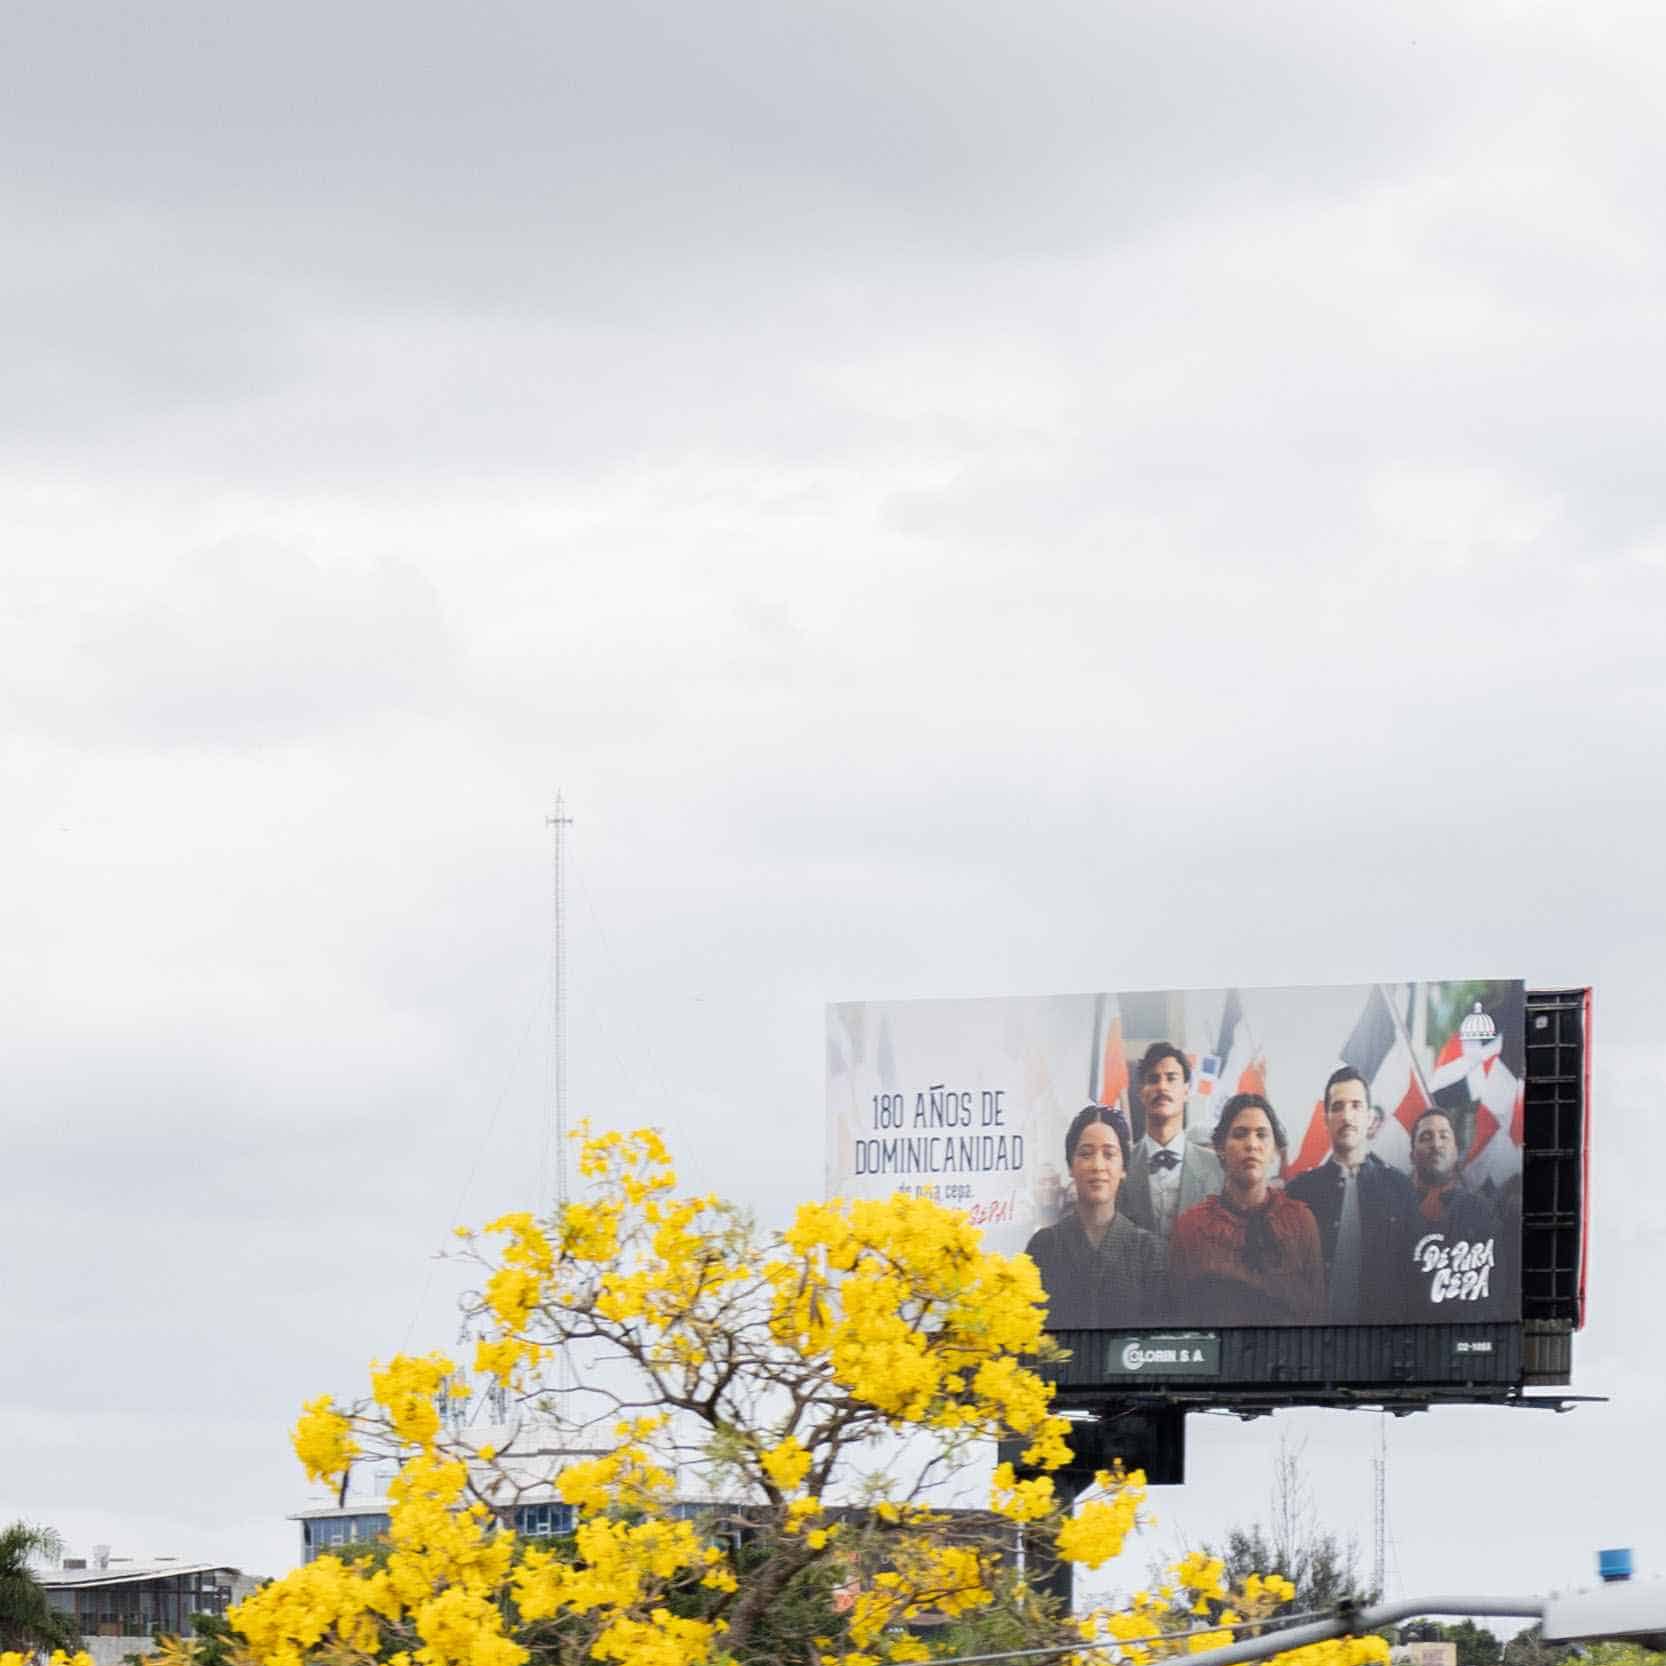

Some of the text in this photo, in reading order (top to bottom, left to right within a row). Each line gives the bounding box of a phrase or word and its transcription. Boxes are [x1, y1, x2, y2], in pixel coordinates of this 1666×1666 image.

[872, 1084, 1006, 1130] 180 AÑOS DE
[855, 1135, 1024, 1175] DOMINICANIDAD
